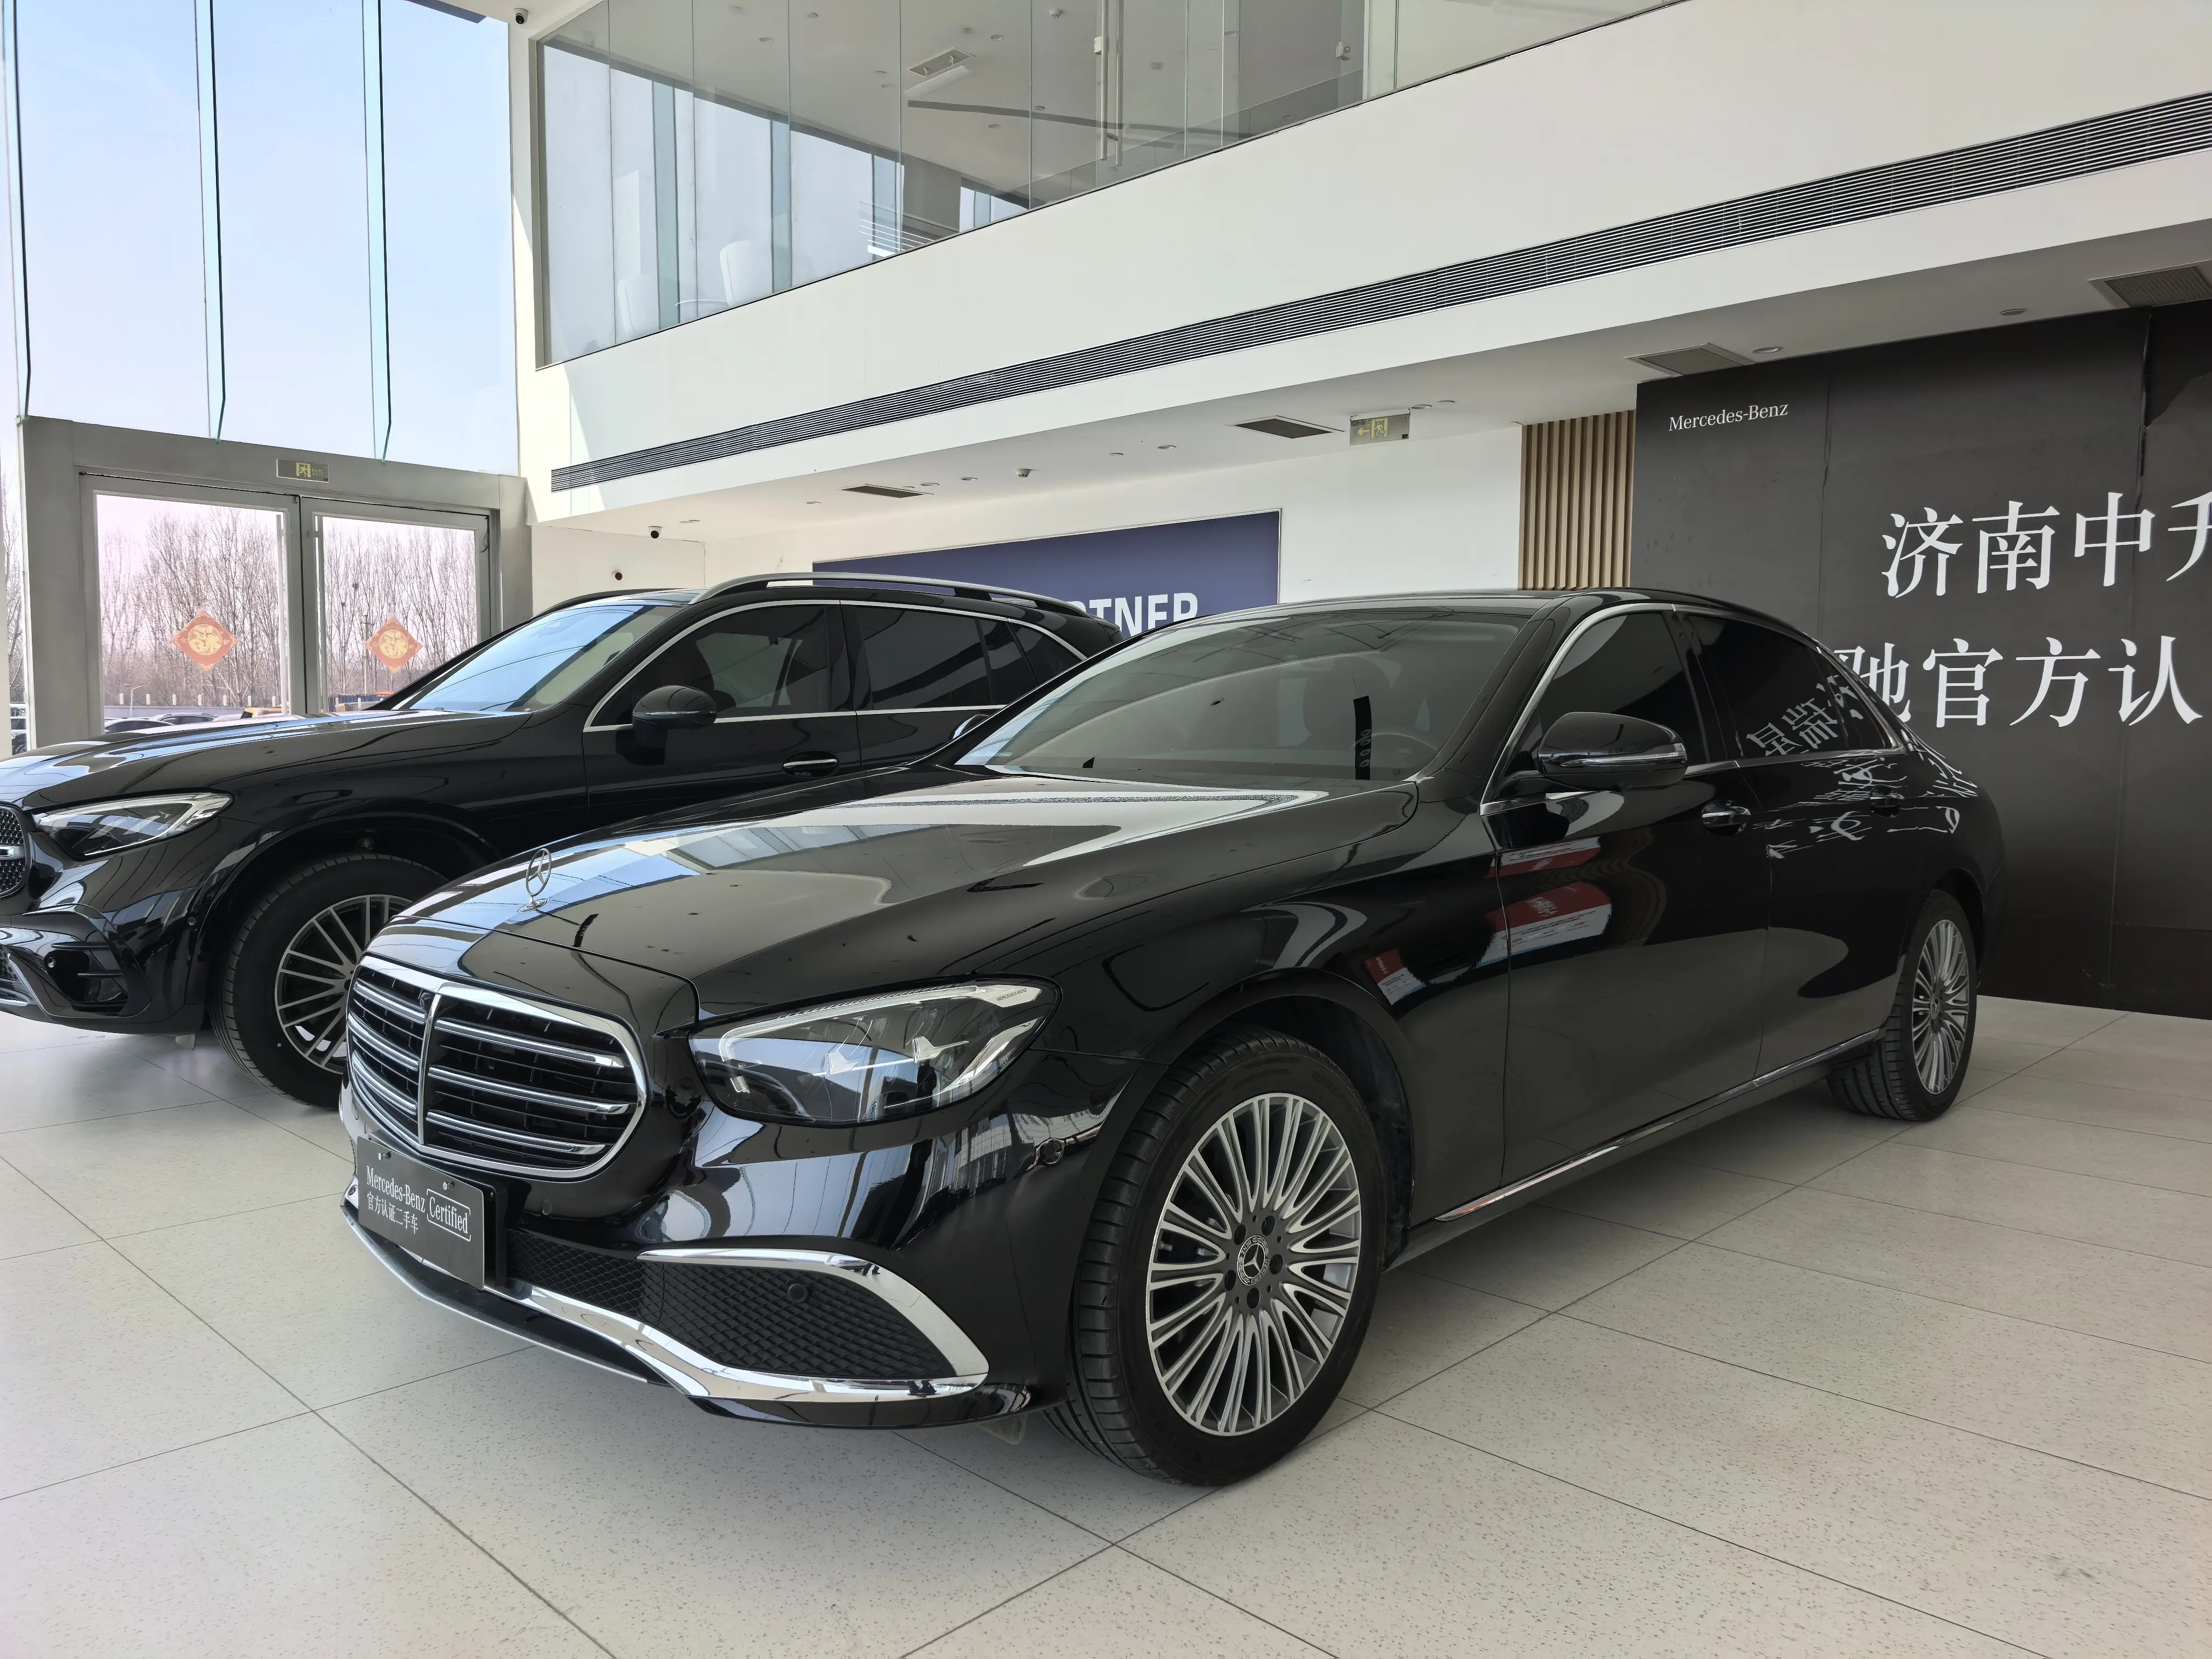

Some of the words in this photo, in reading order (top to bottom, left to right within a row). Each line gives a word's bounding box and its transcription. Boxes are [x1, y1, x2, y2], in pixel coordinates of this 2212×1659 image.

[1668, 404, 1789, 431] Mercedes-Benz
[1066, 592, 1198, 637] TNER
[996, 988, 1028, 1001] MERCEDES-BENZ
[367, 1165, 426, 1213] Mercedes-Benz
[429, 1196, 468, 1235] Certified
[367, 1191, 419, 1234] 官方认证二手车
